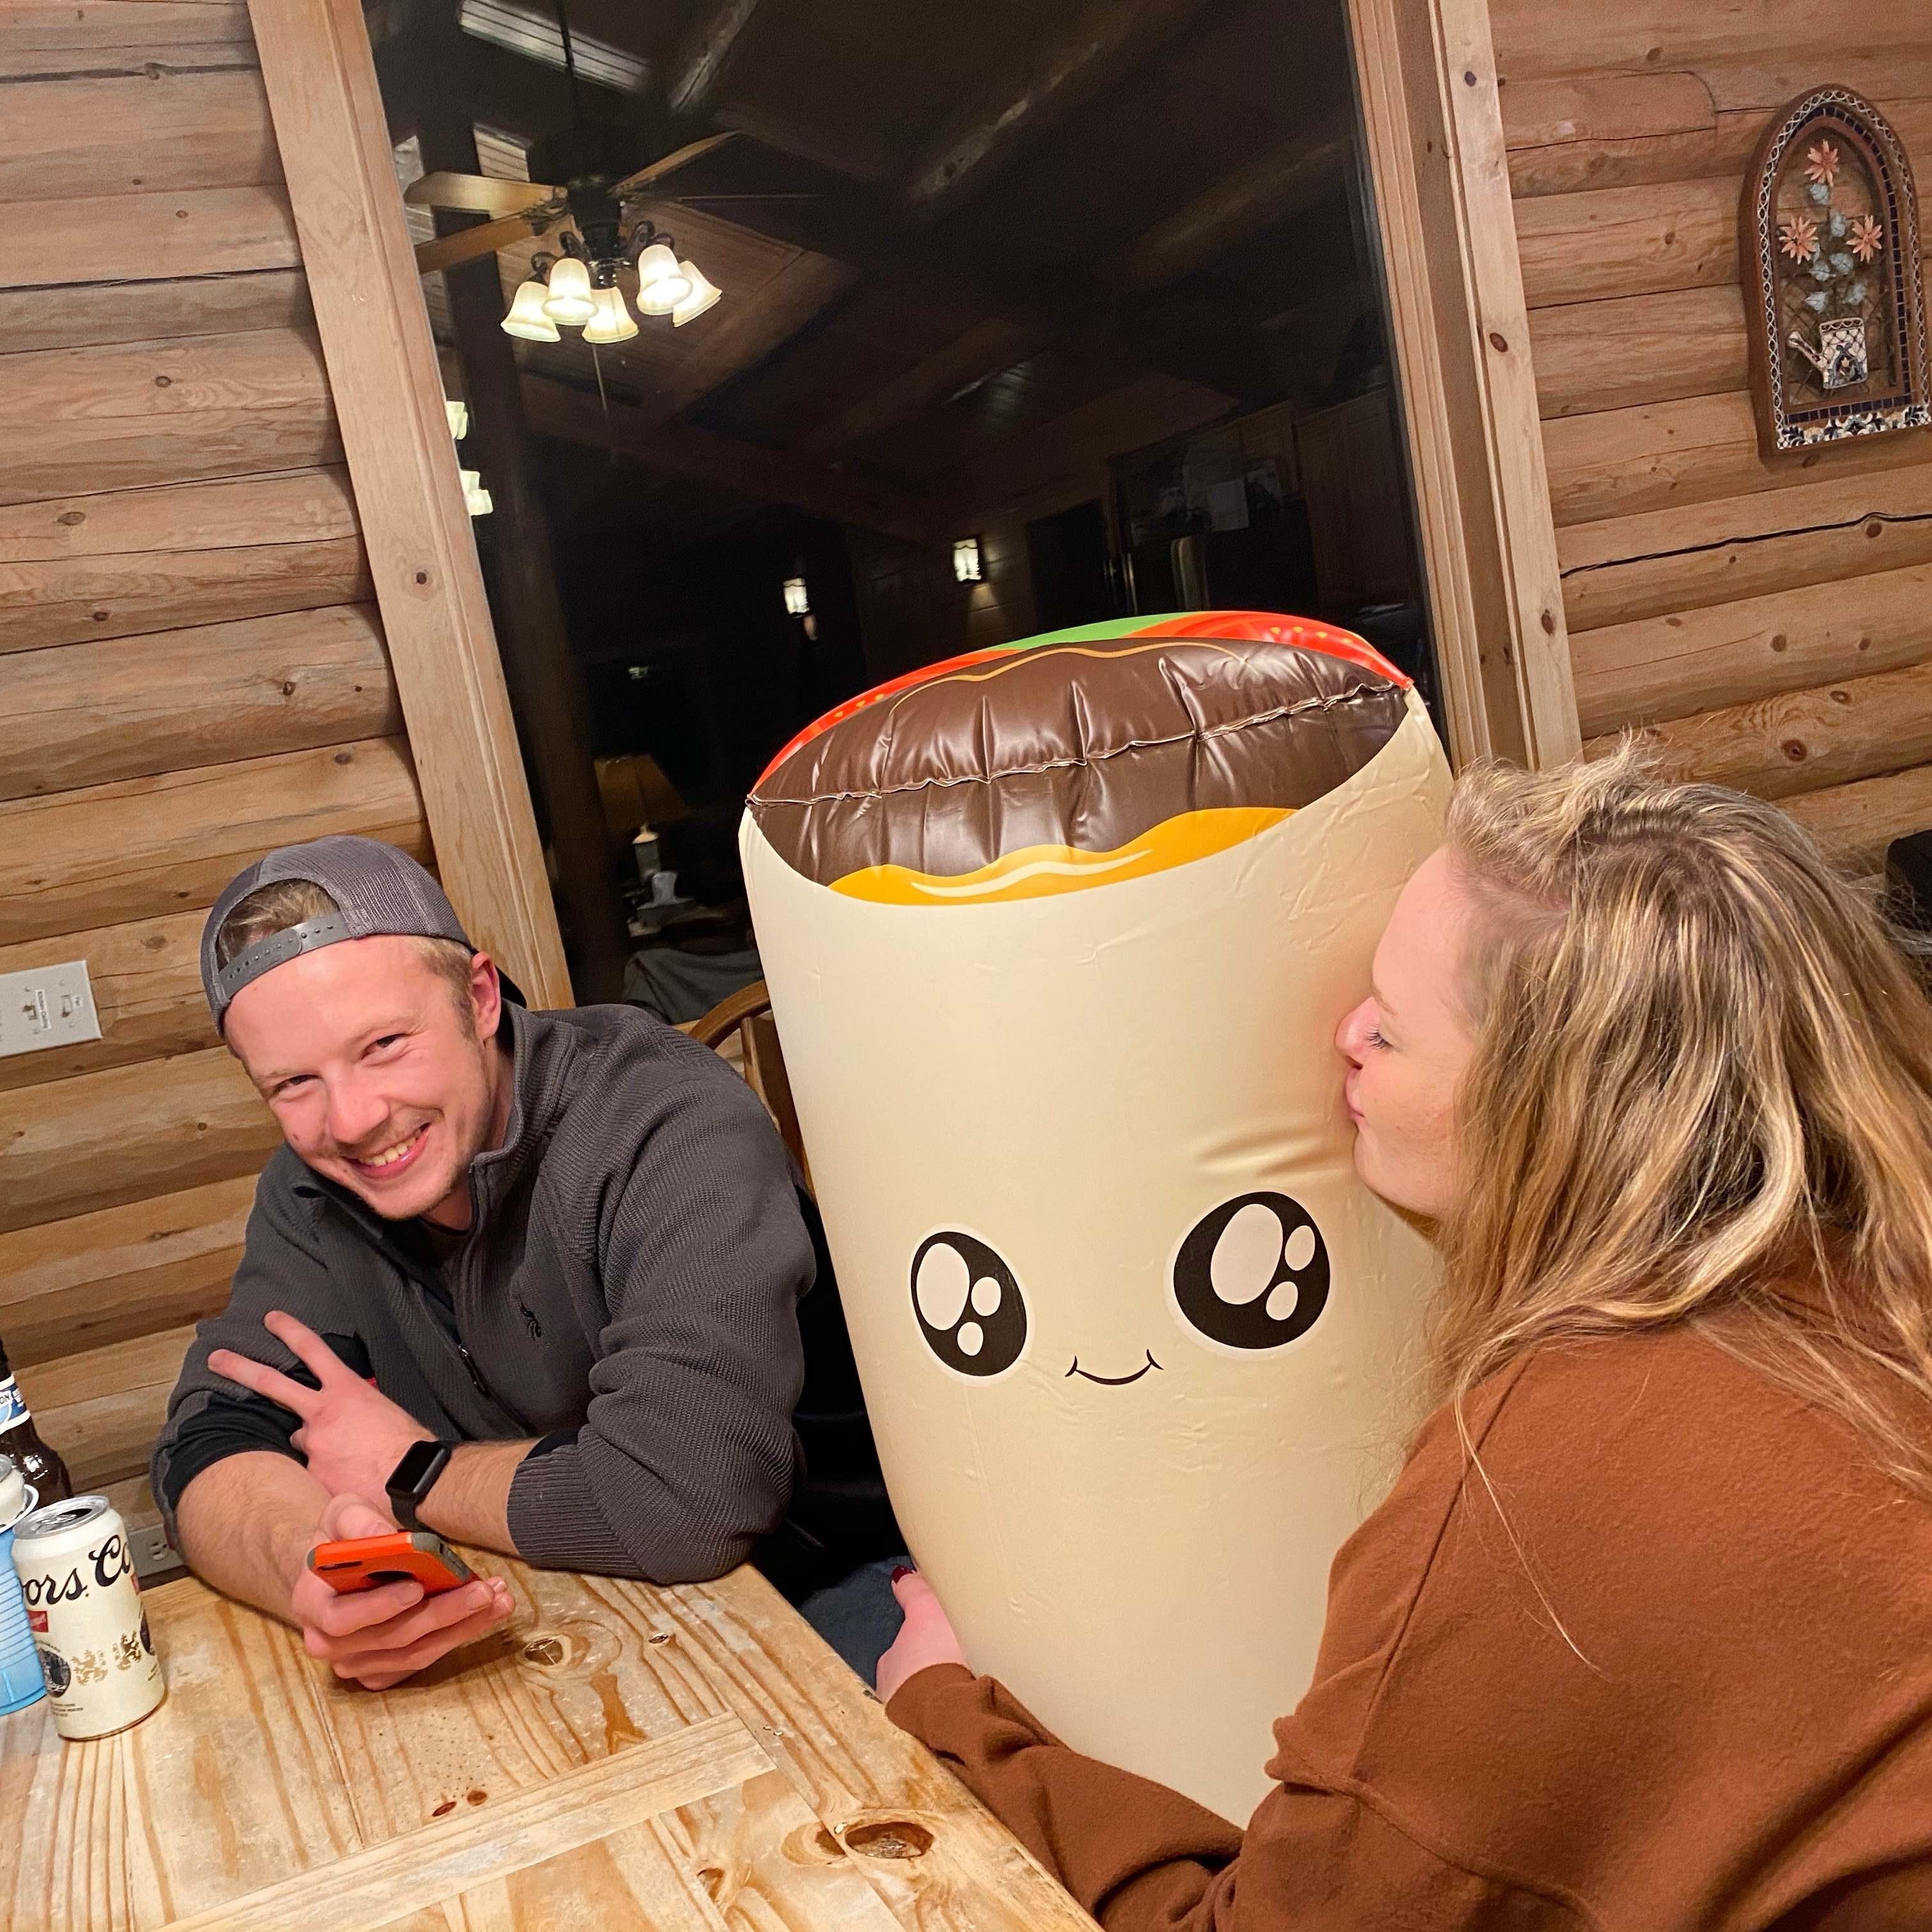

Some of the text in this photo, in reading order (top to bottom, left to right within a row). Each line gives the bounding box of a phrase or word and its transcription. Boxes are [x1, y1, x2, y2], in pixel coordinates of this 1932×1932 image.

[0, 1393, 11, 1404] ON
[20, 1567, 88, 1606] ors
[88, 1535, 130, 1587] Co
